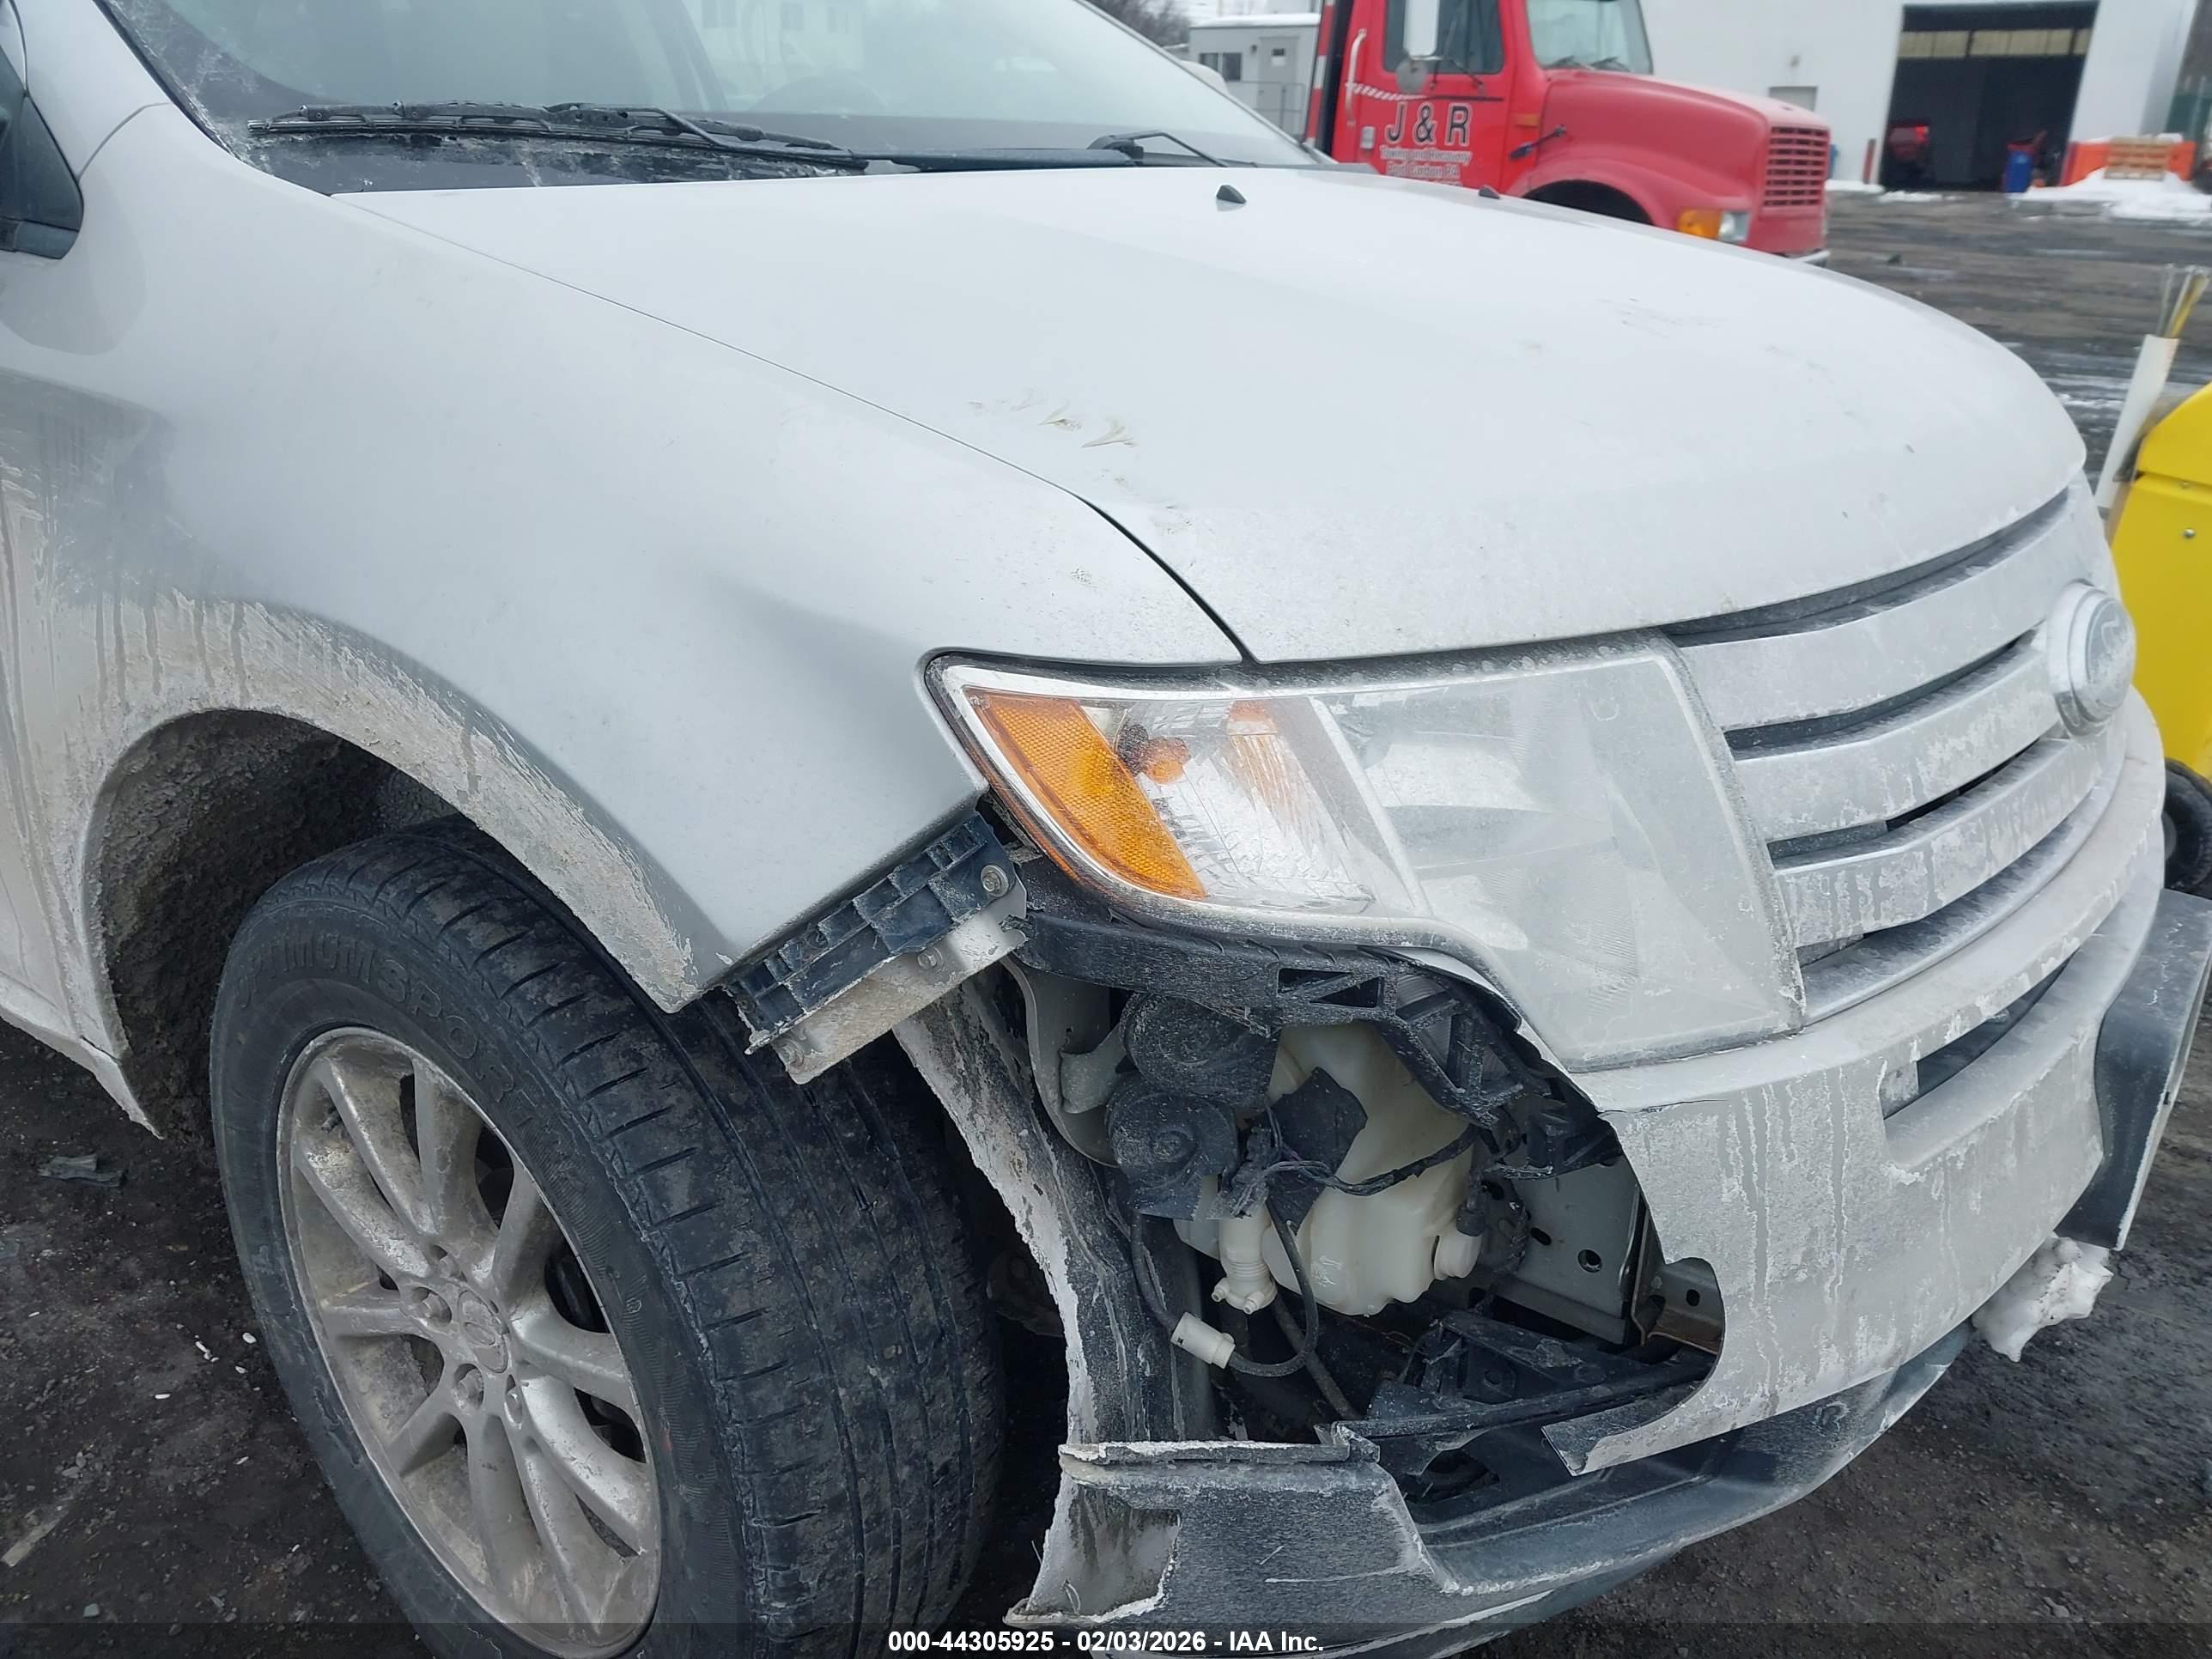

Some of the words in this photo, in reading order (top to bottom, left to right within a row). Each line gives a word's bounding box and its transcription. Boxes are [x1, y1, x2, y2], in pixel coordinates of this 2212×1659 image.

[1385, 100, 1407, 144] J
[1413, 101, 1437, 145] &
[1444, 102, 1472, 146] R
